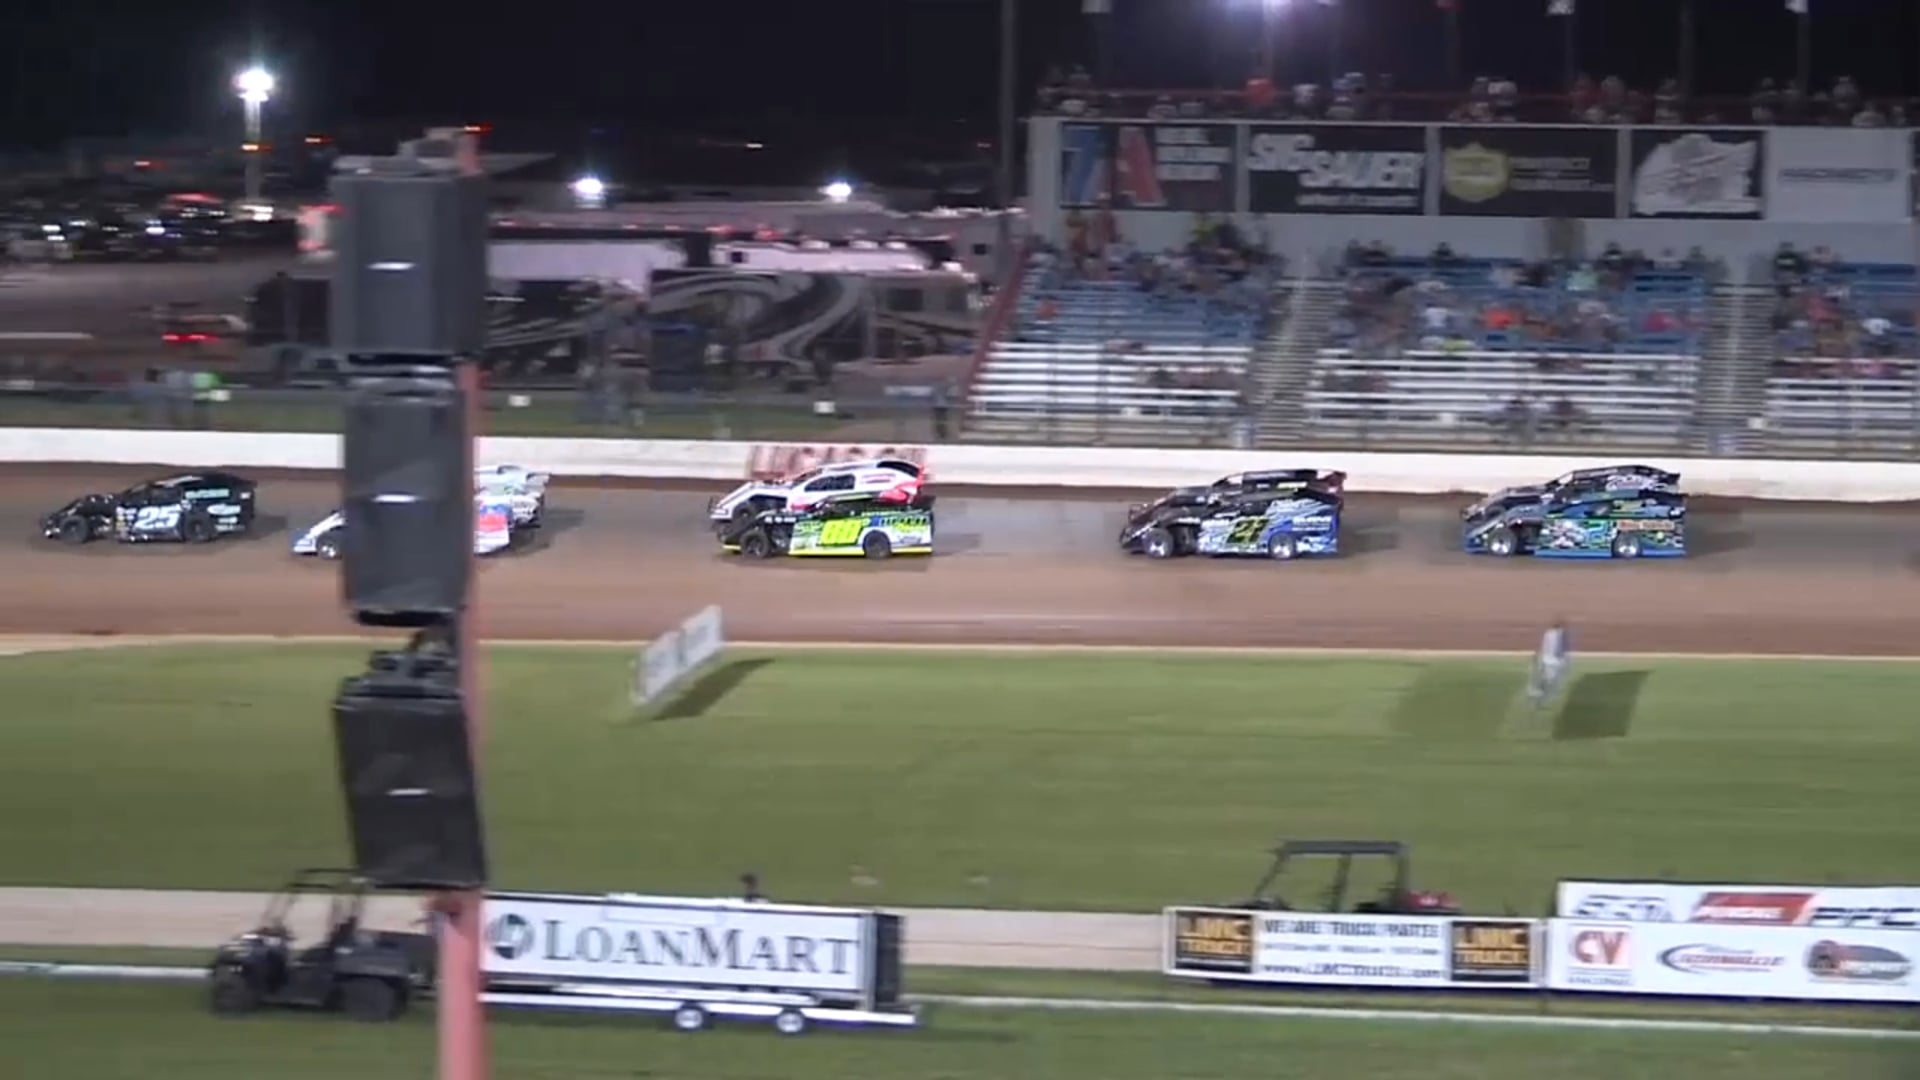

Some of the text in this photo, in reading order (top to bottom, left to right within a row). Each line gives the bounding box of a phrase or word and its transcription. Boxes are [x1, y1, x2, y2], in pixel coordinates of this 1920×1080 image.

[1246, 133, 1315, 171] SIG
[1298, 150, 1425, 188] SAUER
[135, 504, 181, 530] 25
